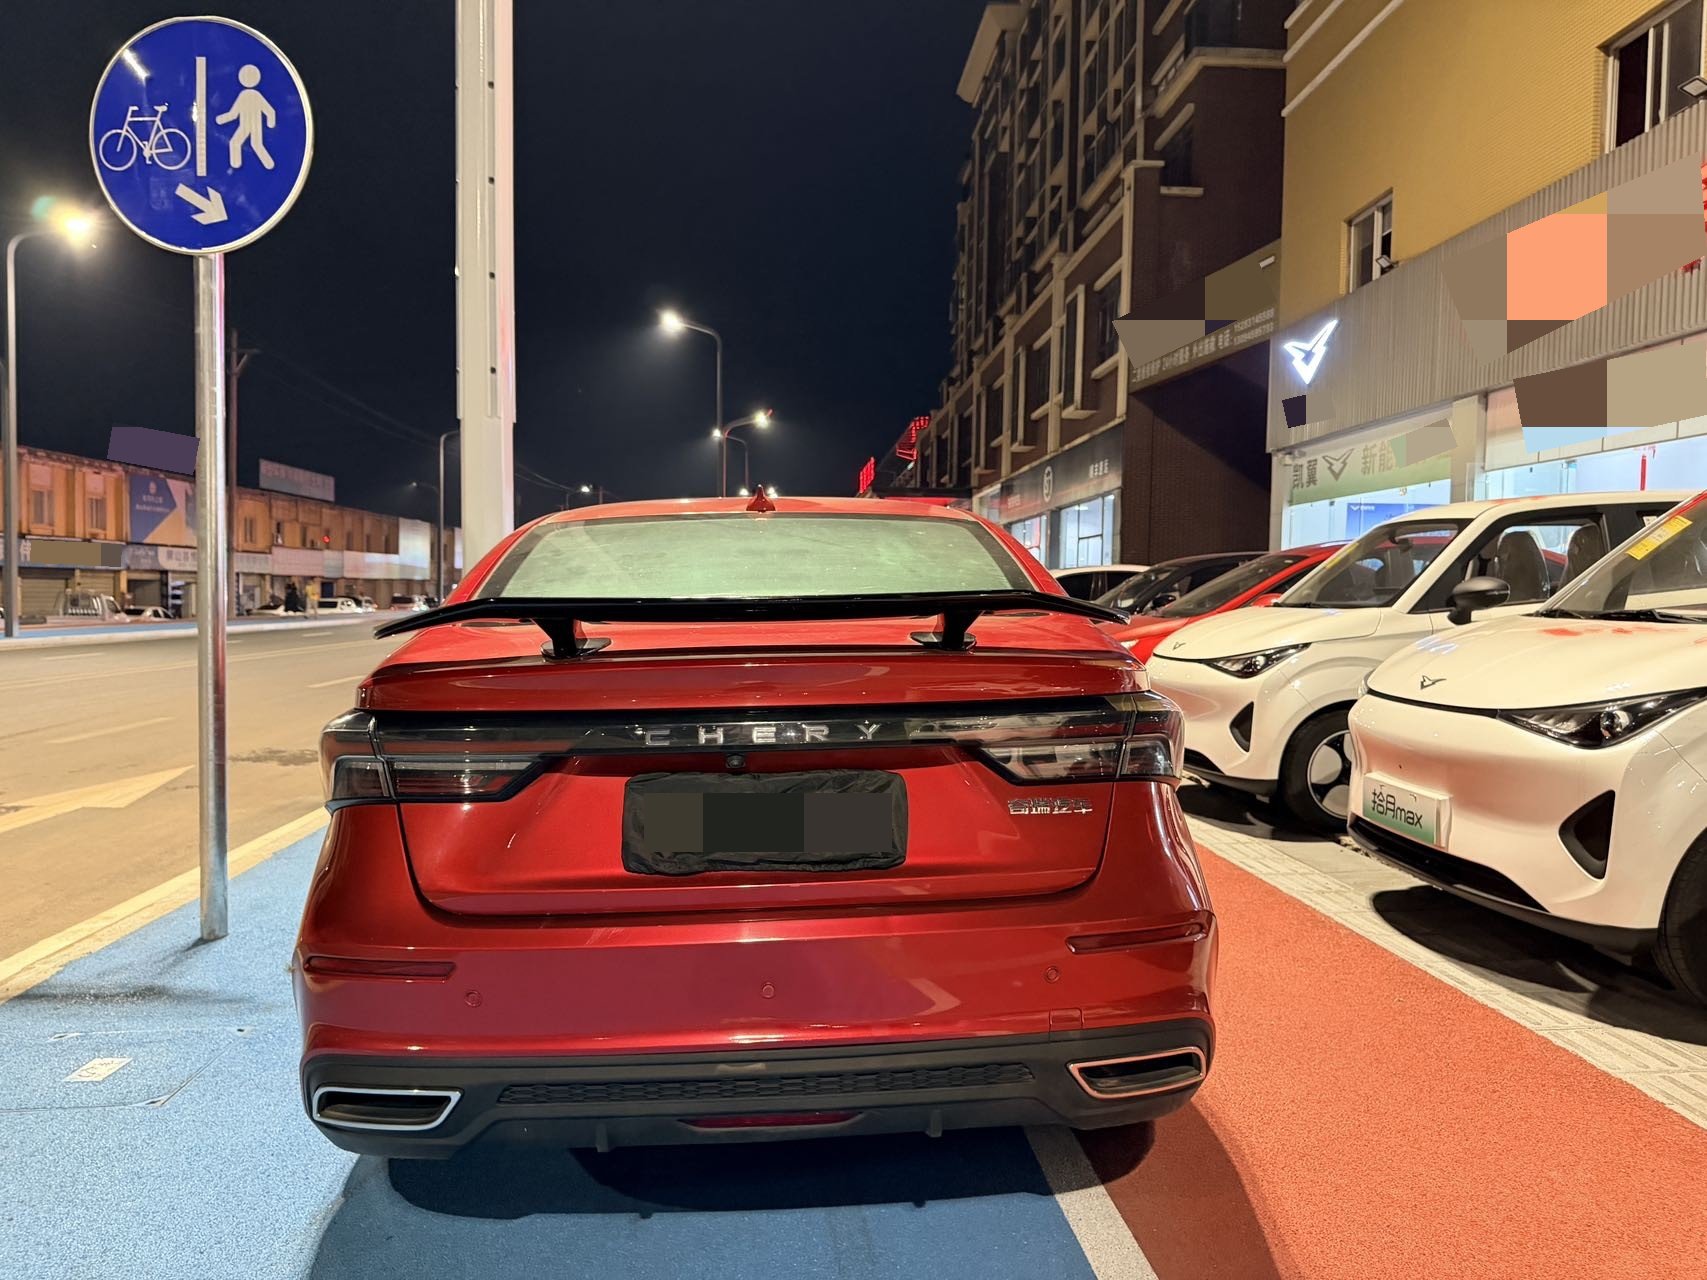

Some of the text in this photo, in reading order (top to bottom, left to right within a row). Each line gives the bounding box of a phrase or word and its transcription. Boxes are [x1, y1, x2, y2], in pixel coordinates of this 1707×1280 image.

[645, 723, 881, 746] CHERY
[1008, 797, 1093, 815] 奇瑞汽车
[1371, 788, 1423, 829] 拾月max
